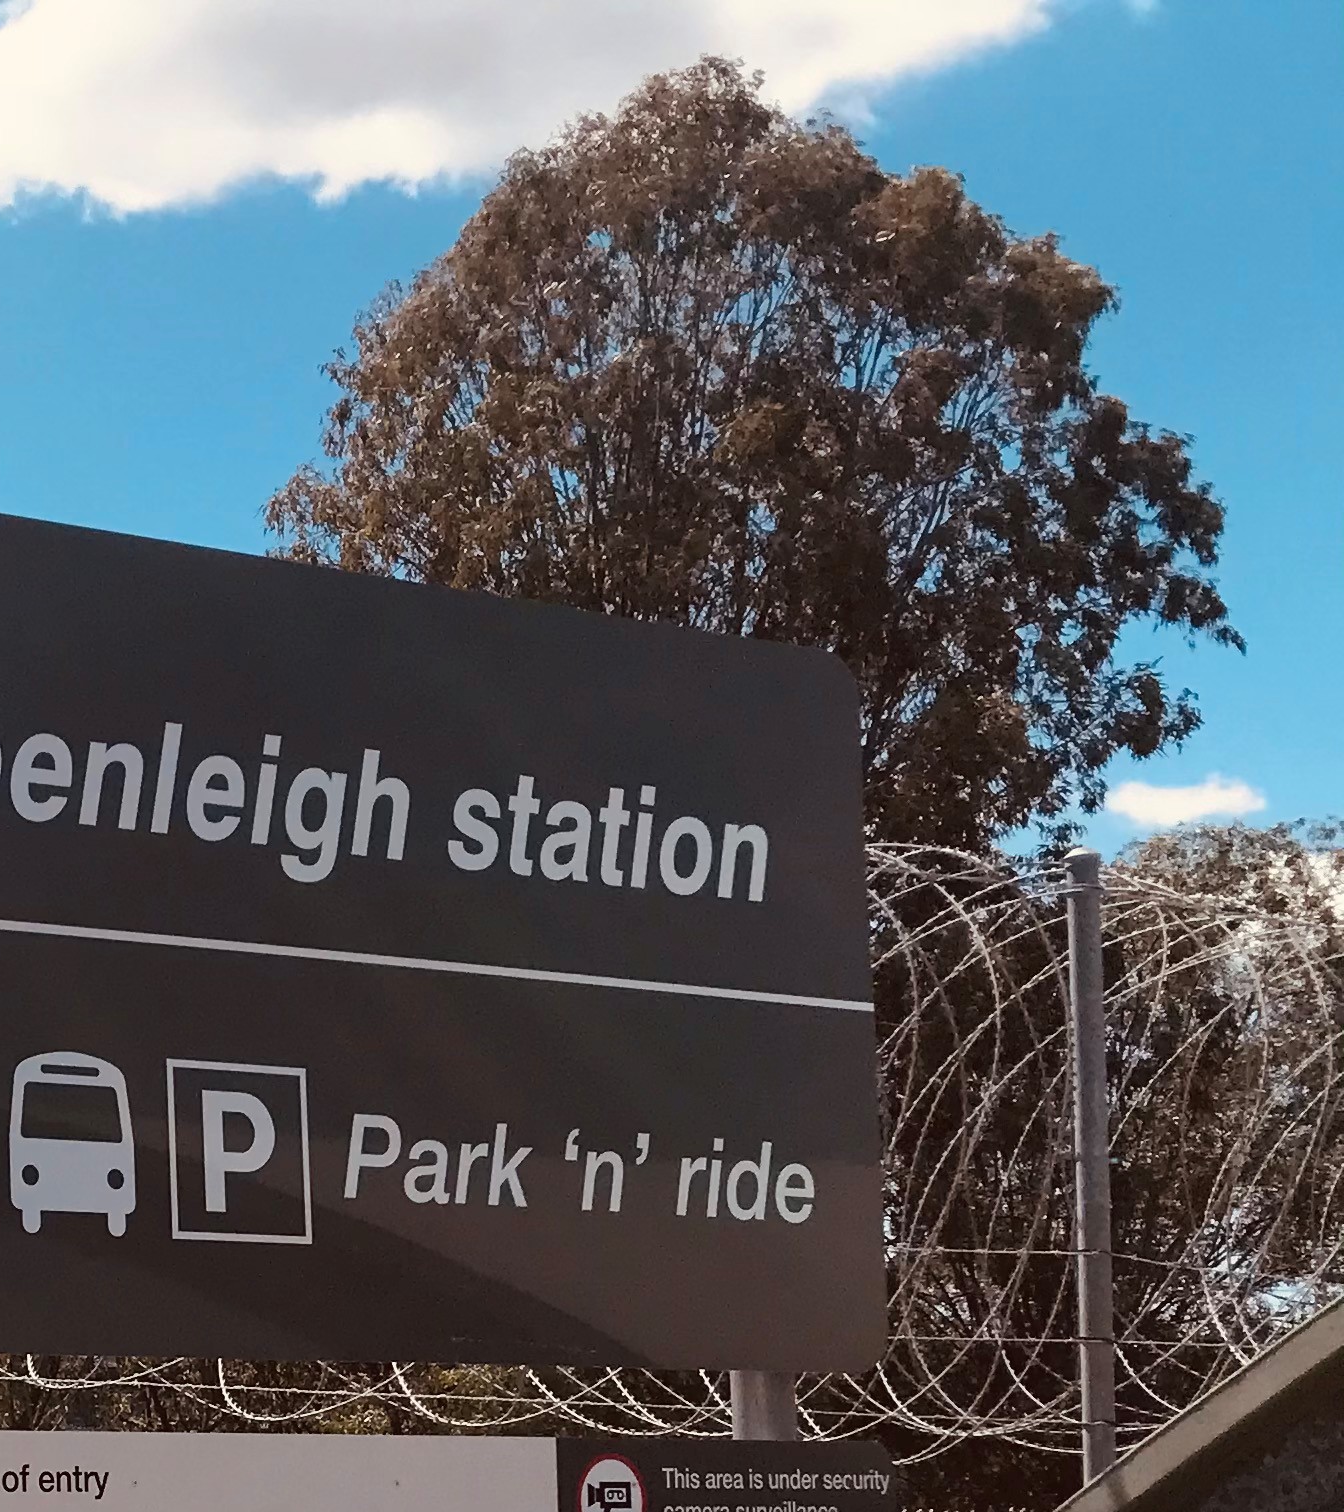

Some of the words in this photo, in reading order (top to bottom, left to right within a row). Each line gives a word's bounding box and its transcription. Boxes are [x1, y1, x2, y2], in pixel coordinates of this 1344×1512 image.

[447, 774, 769, 903] station
[201, 1089, 276, 1216] P
[343, 1113, 534, 1208] Park
[676, 1137, 815, 1224] ride
[1, 1463, 30, 1493] of
[38, 1465, 110, 1500] entry
[661, 1467, 701, 1489] This
[705, 1472, 745, 1490] area
[748, 1468, 764, 1490] is
[768, 1468, 819, 1490] under
[822, 1469, 890, 1495] security
